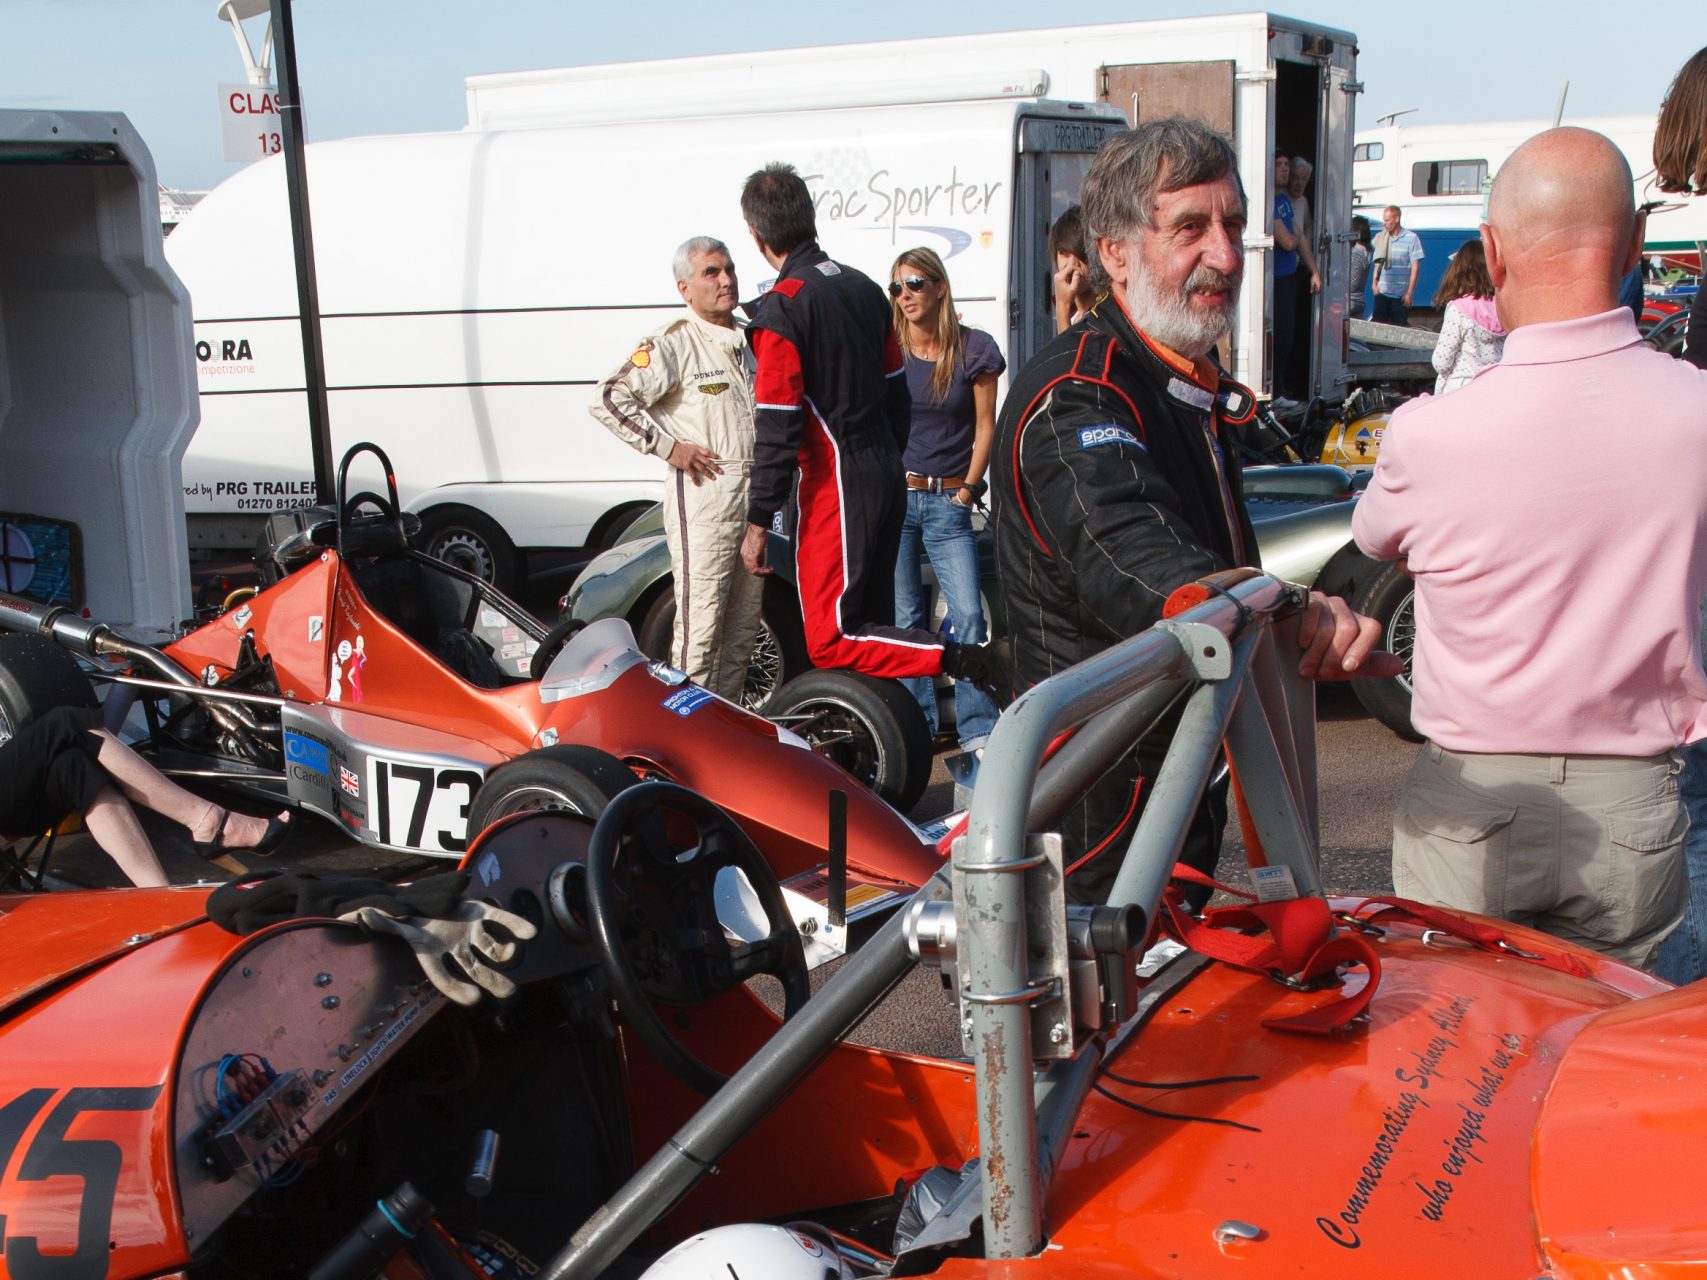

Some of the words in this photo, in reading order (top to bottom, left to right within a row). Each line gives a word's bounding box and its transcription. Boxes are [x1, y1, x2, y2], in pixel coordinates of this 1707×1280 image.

[258, 133, 282, 154] 13
[694, 369, 725, 380] DUNLOP
[1082, 427, 1139, 443] sparc
[201, 483, 213, 501] by
[216, 482, 248, 495] PRG
[237, 499, 273, 509] 01270
[376, 761, 483, 851] 173
[1491, 1048, 1514, 1070] we
[1465, 1065, 1505, 1108] what
[1316, 1091, 1431, 1249] Commemorating
[1395, 1035, 1460, 1090] Sydney
[1442, 1103, 1489, 1176] enjoyed
[1415, 1180, 1454, 1221] who
